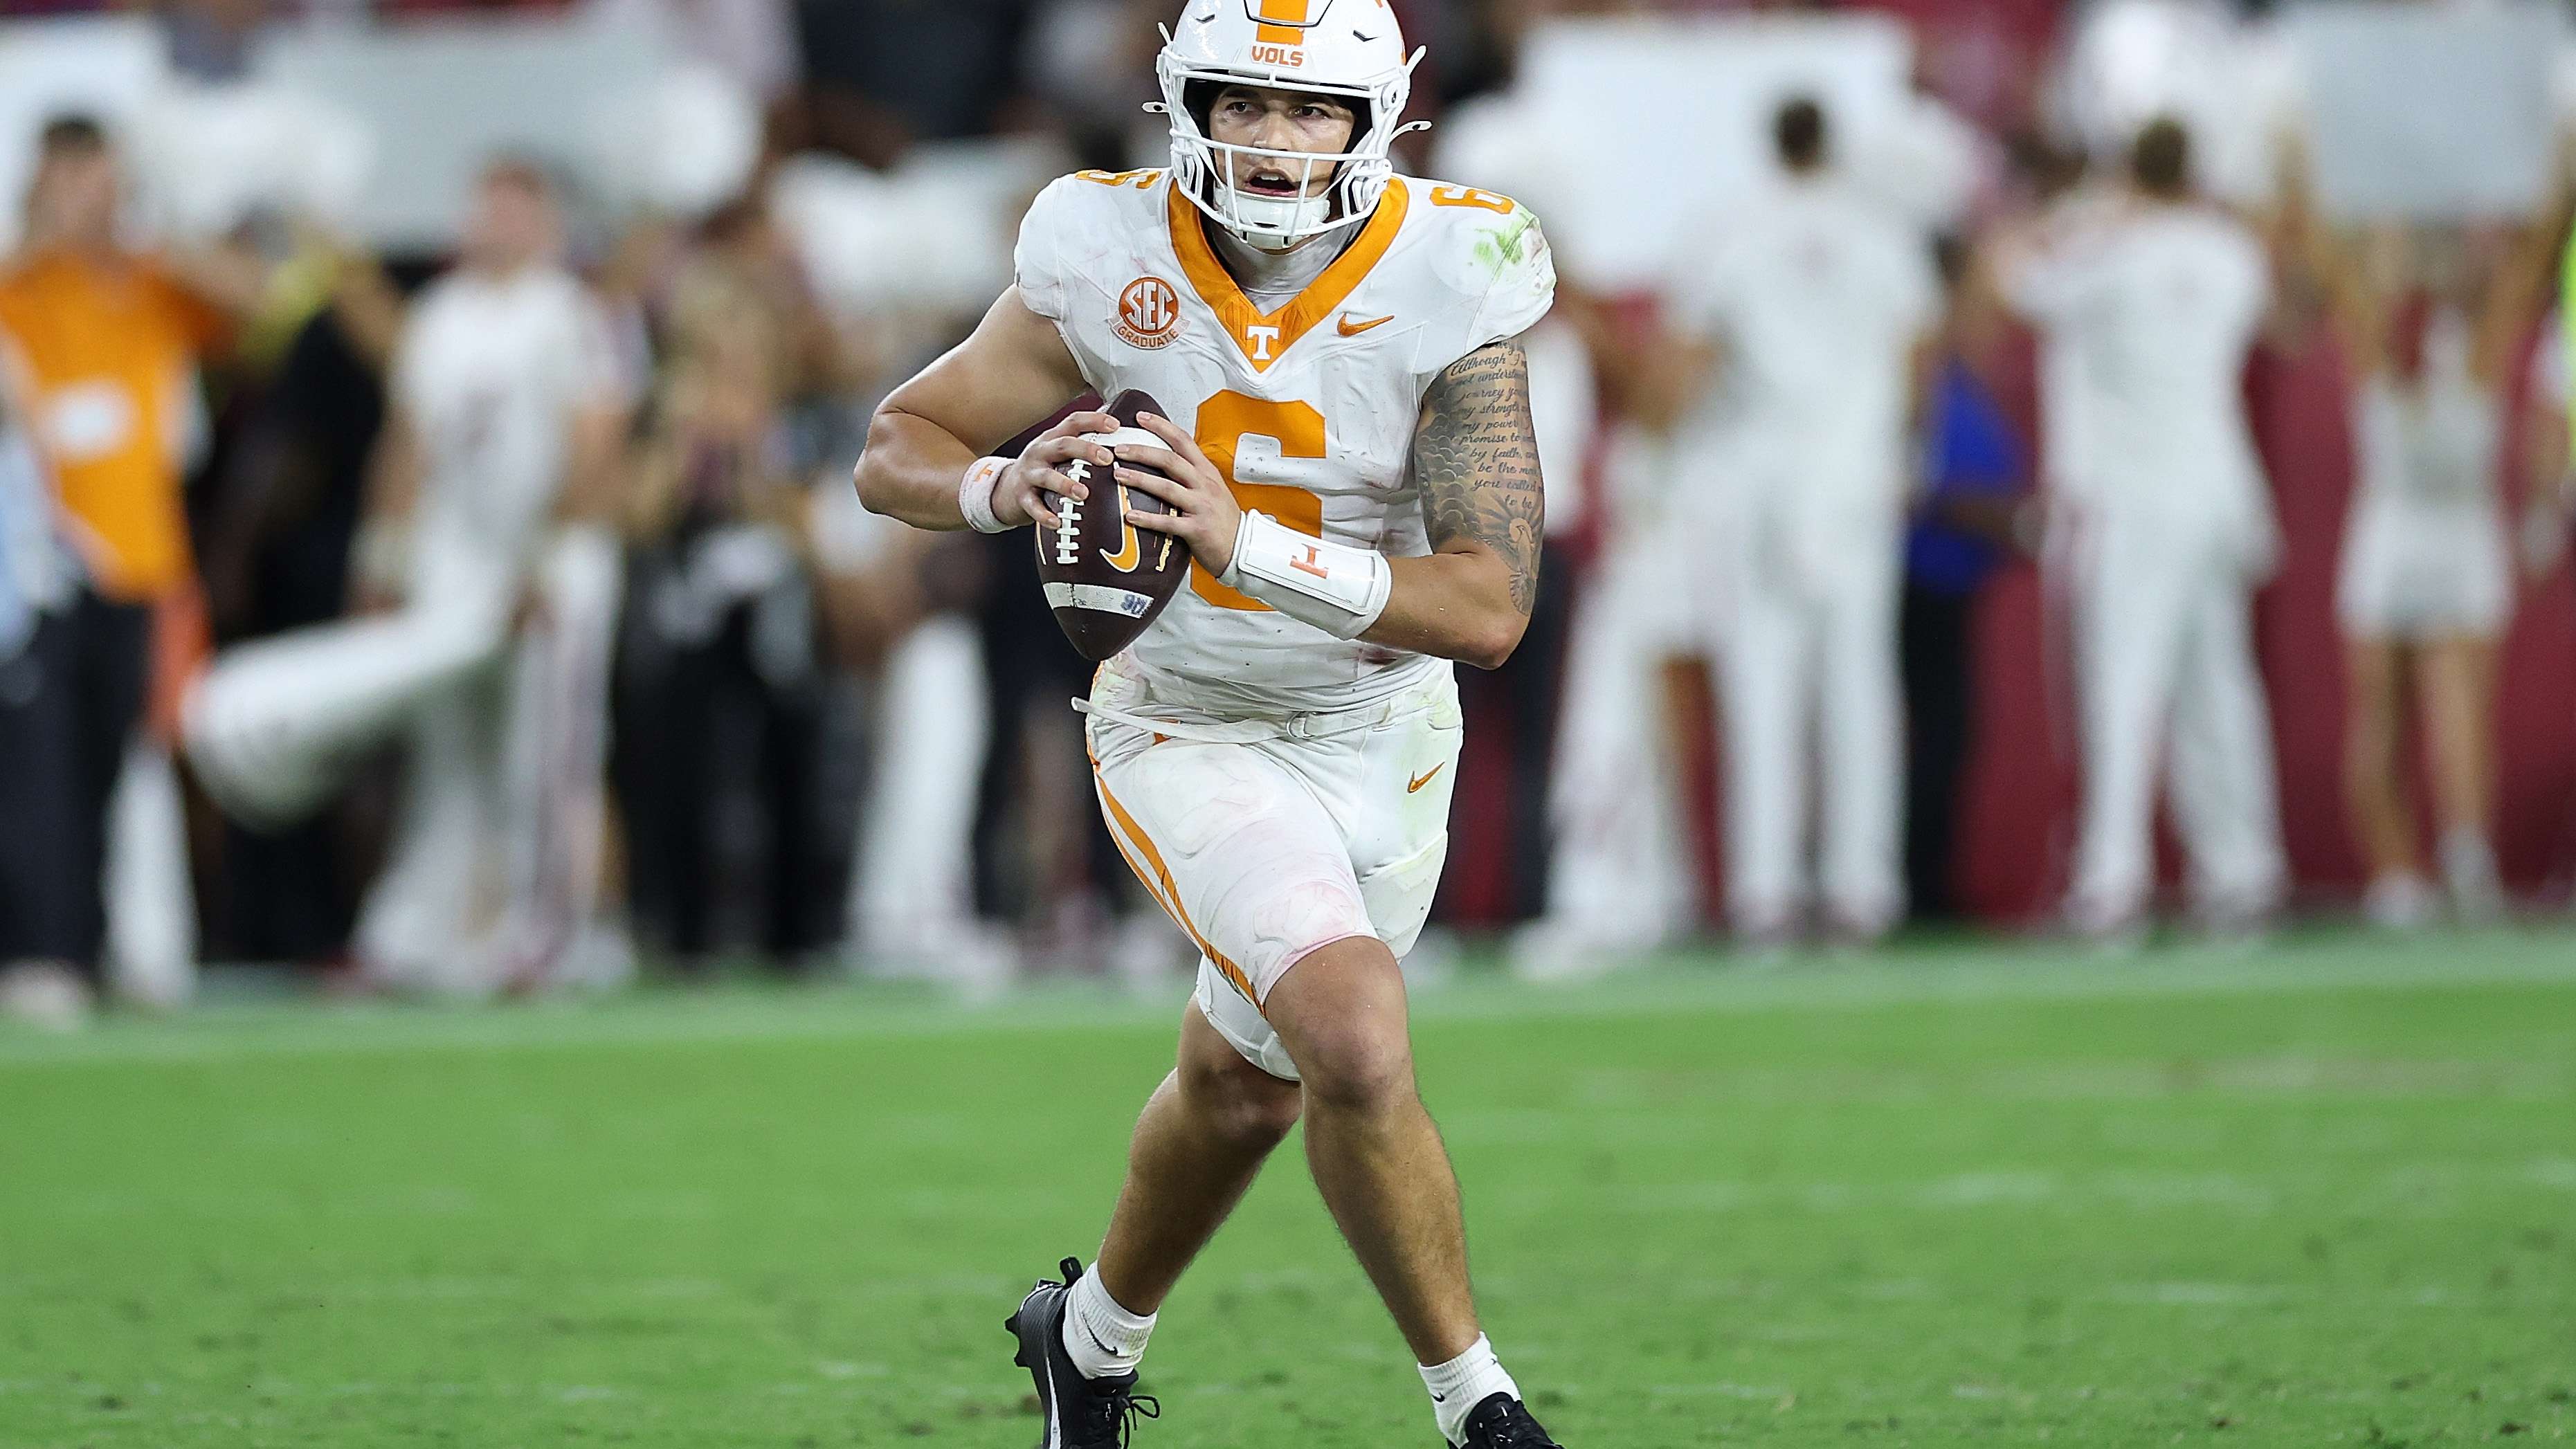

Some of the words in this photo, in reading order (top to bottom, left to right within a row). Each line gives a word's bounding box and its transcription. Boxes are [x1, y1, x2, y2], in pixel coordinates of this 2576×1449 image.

[1251, 46, 1304, 66] VOLS
[1429, 186, 1514, 215] 6
[1125, 281, 1174, 331] SEC
[1117, 326, 1179, 347] GRADUATE
[1247, 325, 1279, 360] T
[1459, 433, 1507, 445] promise
[1469, 448, 1487, 464] by
[1498, 462, 1517, 473] the
[1470, 479, 1501, 491] you
[1190, 389, 1327, 612] 6
[1505, 494, 1517, 506] to
[1522, 496, 1533, 509] be
[1290, 543, 1329, 579] T
